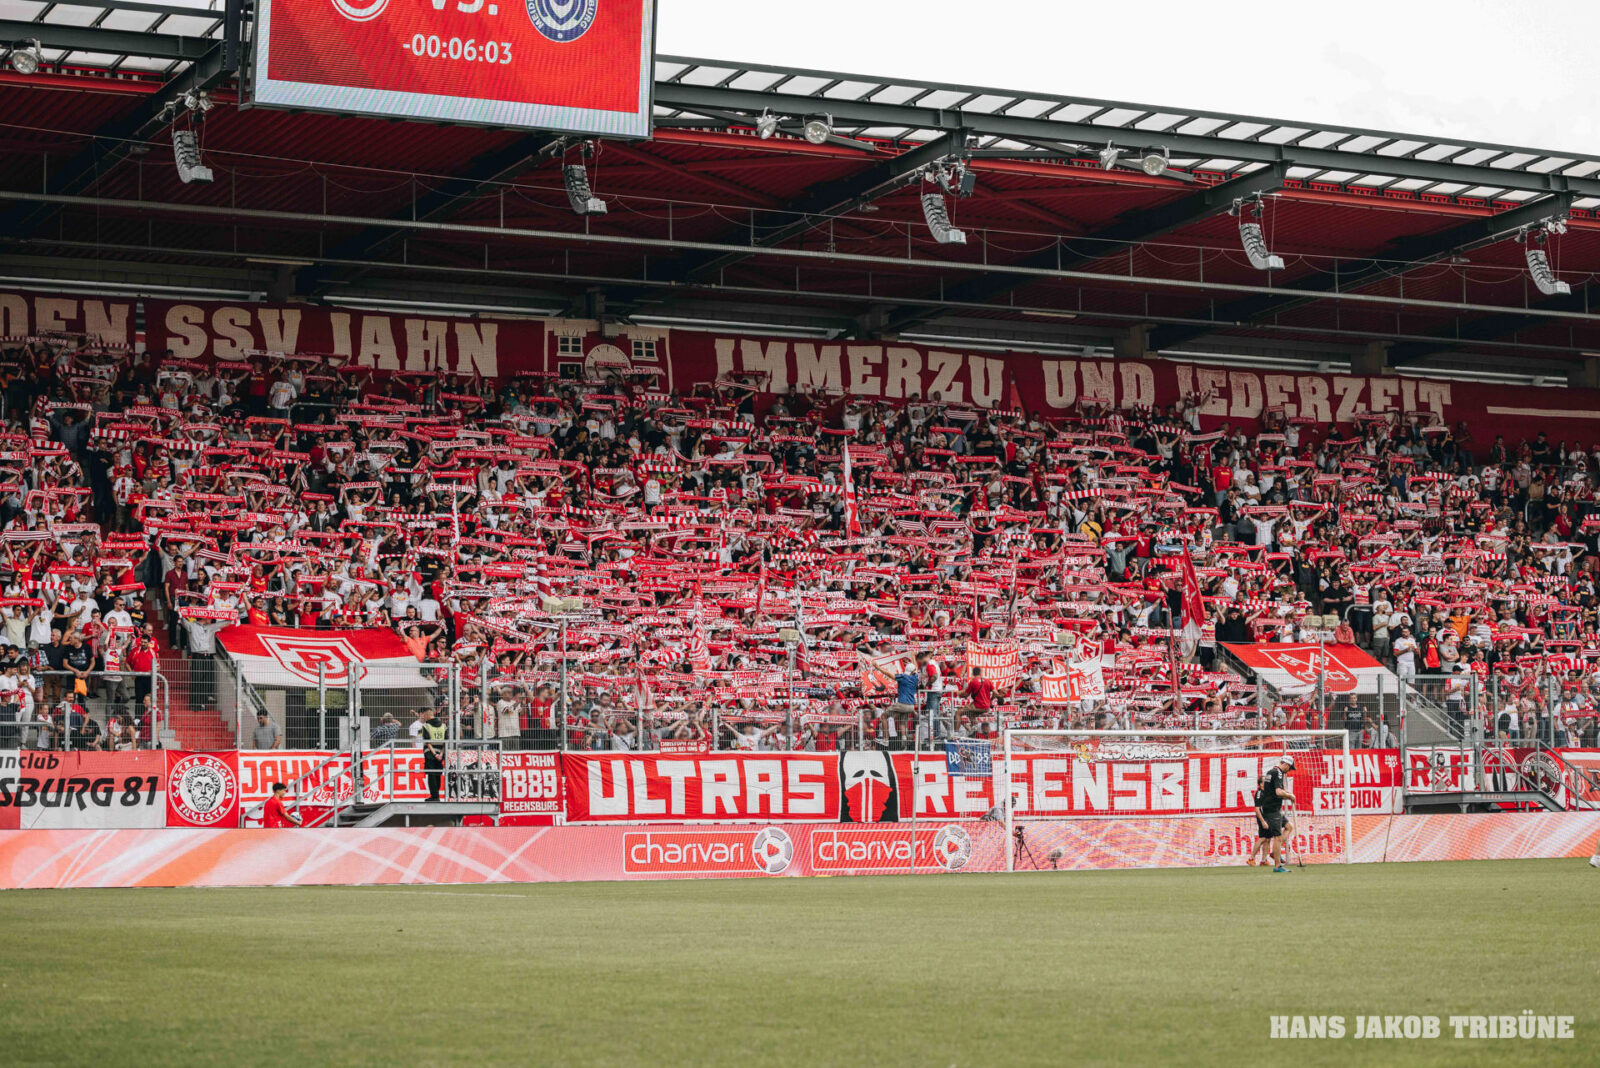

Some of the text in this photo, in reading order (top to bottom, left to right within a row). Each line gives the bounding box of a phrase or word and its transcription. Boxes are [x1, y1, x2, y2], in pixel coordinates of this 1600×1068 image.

[403, 33, 513, 66] -00:06:03
[164, 304, 301, 362] SSV
[329, 312, 499, 379] JAHN
[714, 338, 1452, 425] IMMERZU UND JEDERZEIT
[969, 652, 1017, 666] HUNDERT
[501, 755, 521, 767] SSV
[525, 755, 555, 767] JAHN
[1321, 754, 1380, 785] JAHN
[120, 776, 158, 807] 81
[502, 769, 557, 799] 1889
[587, 755, 1290, 816] ULTRAS REGENSBUR
[1320, 789, 1382, 809] STADION
[503, 801, 559, 811] REGENSBURG
[630, 834, 744, 863] charivari
[818, 832, 925, 861] charivari
[1204, 825, 1331, 856] Jahein!
